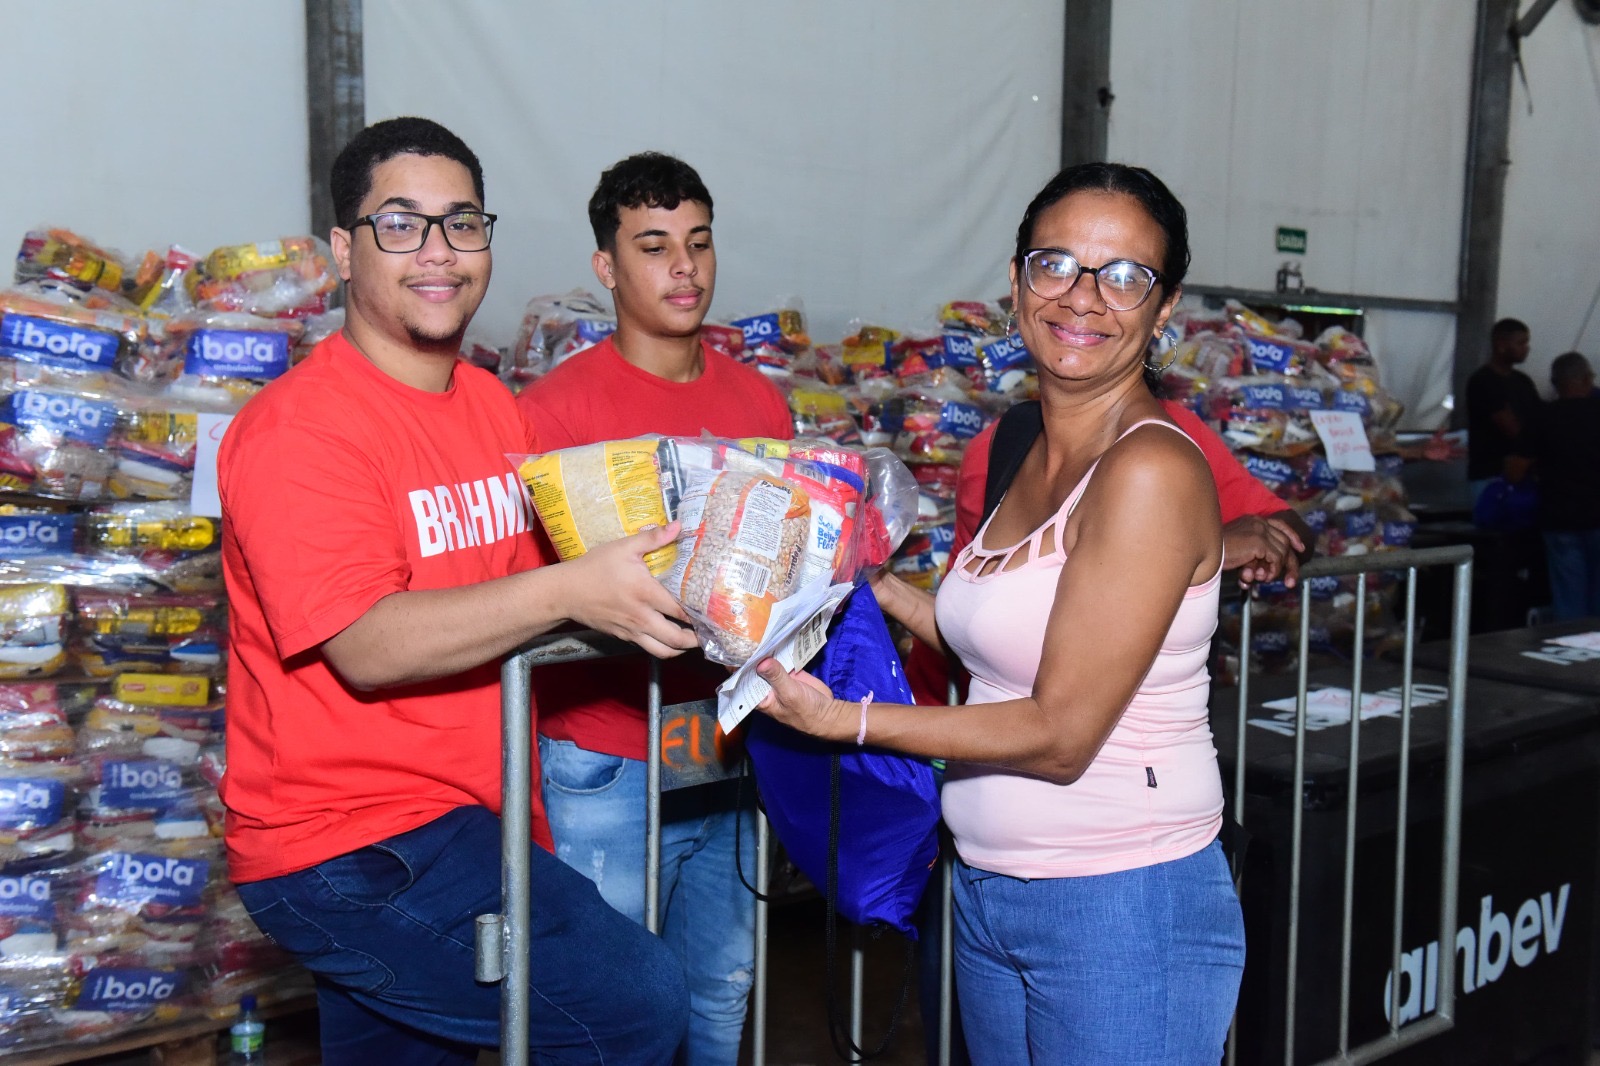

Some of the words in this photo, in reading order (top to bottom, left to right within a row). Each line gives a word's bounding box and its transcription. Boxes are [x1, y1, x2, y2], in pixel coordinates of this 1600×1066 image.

[22, 321, 102, 362] bora
[743, 319, 772, 338] ora
[202, 335, 273, 363] bora
[23, 391, 101, 427] bora
[953, 405, 981, 429] bora
[0, 521, 59, 544] ora
[784, 544, 802, 587] Popular
[121, 763, 182, 788] bora
[0, 782, 50, 809] ora
[121, 854, 194, 886] bora
[0, 875, 51, 902] ora
[1384, 883, 1570, 1027] ambev
[102, 975, 175, 1000] bora
